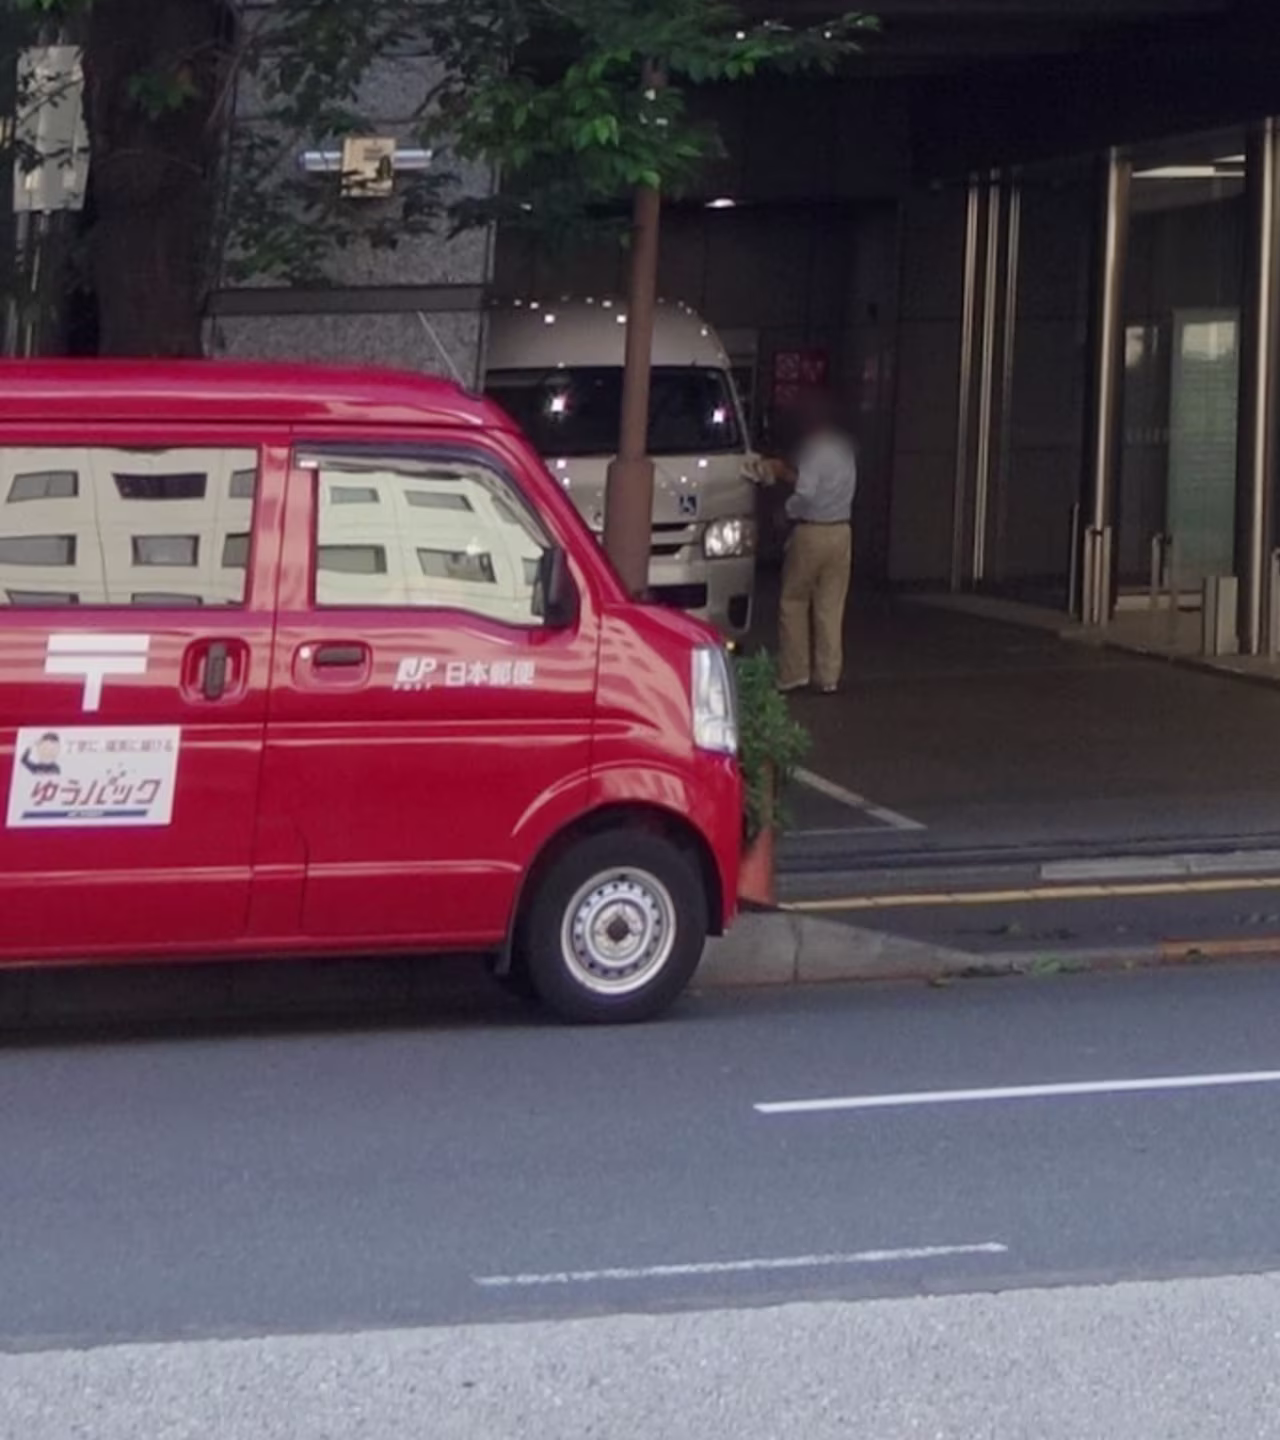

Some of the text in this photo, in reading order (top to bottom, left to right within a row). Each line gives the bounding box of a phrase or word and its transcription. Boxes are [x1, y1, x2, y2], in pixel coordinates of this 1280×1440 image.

[445, 661, 535, 687] 日本郵便
[31, 775, 162, 807] ゆうパック
